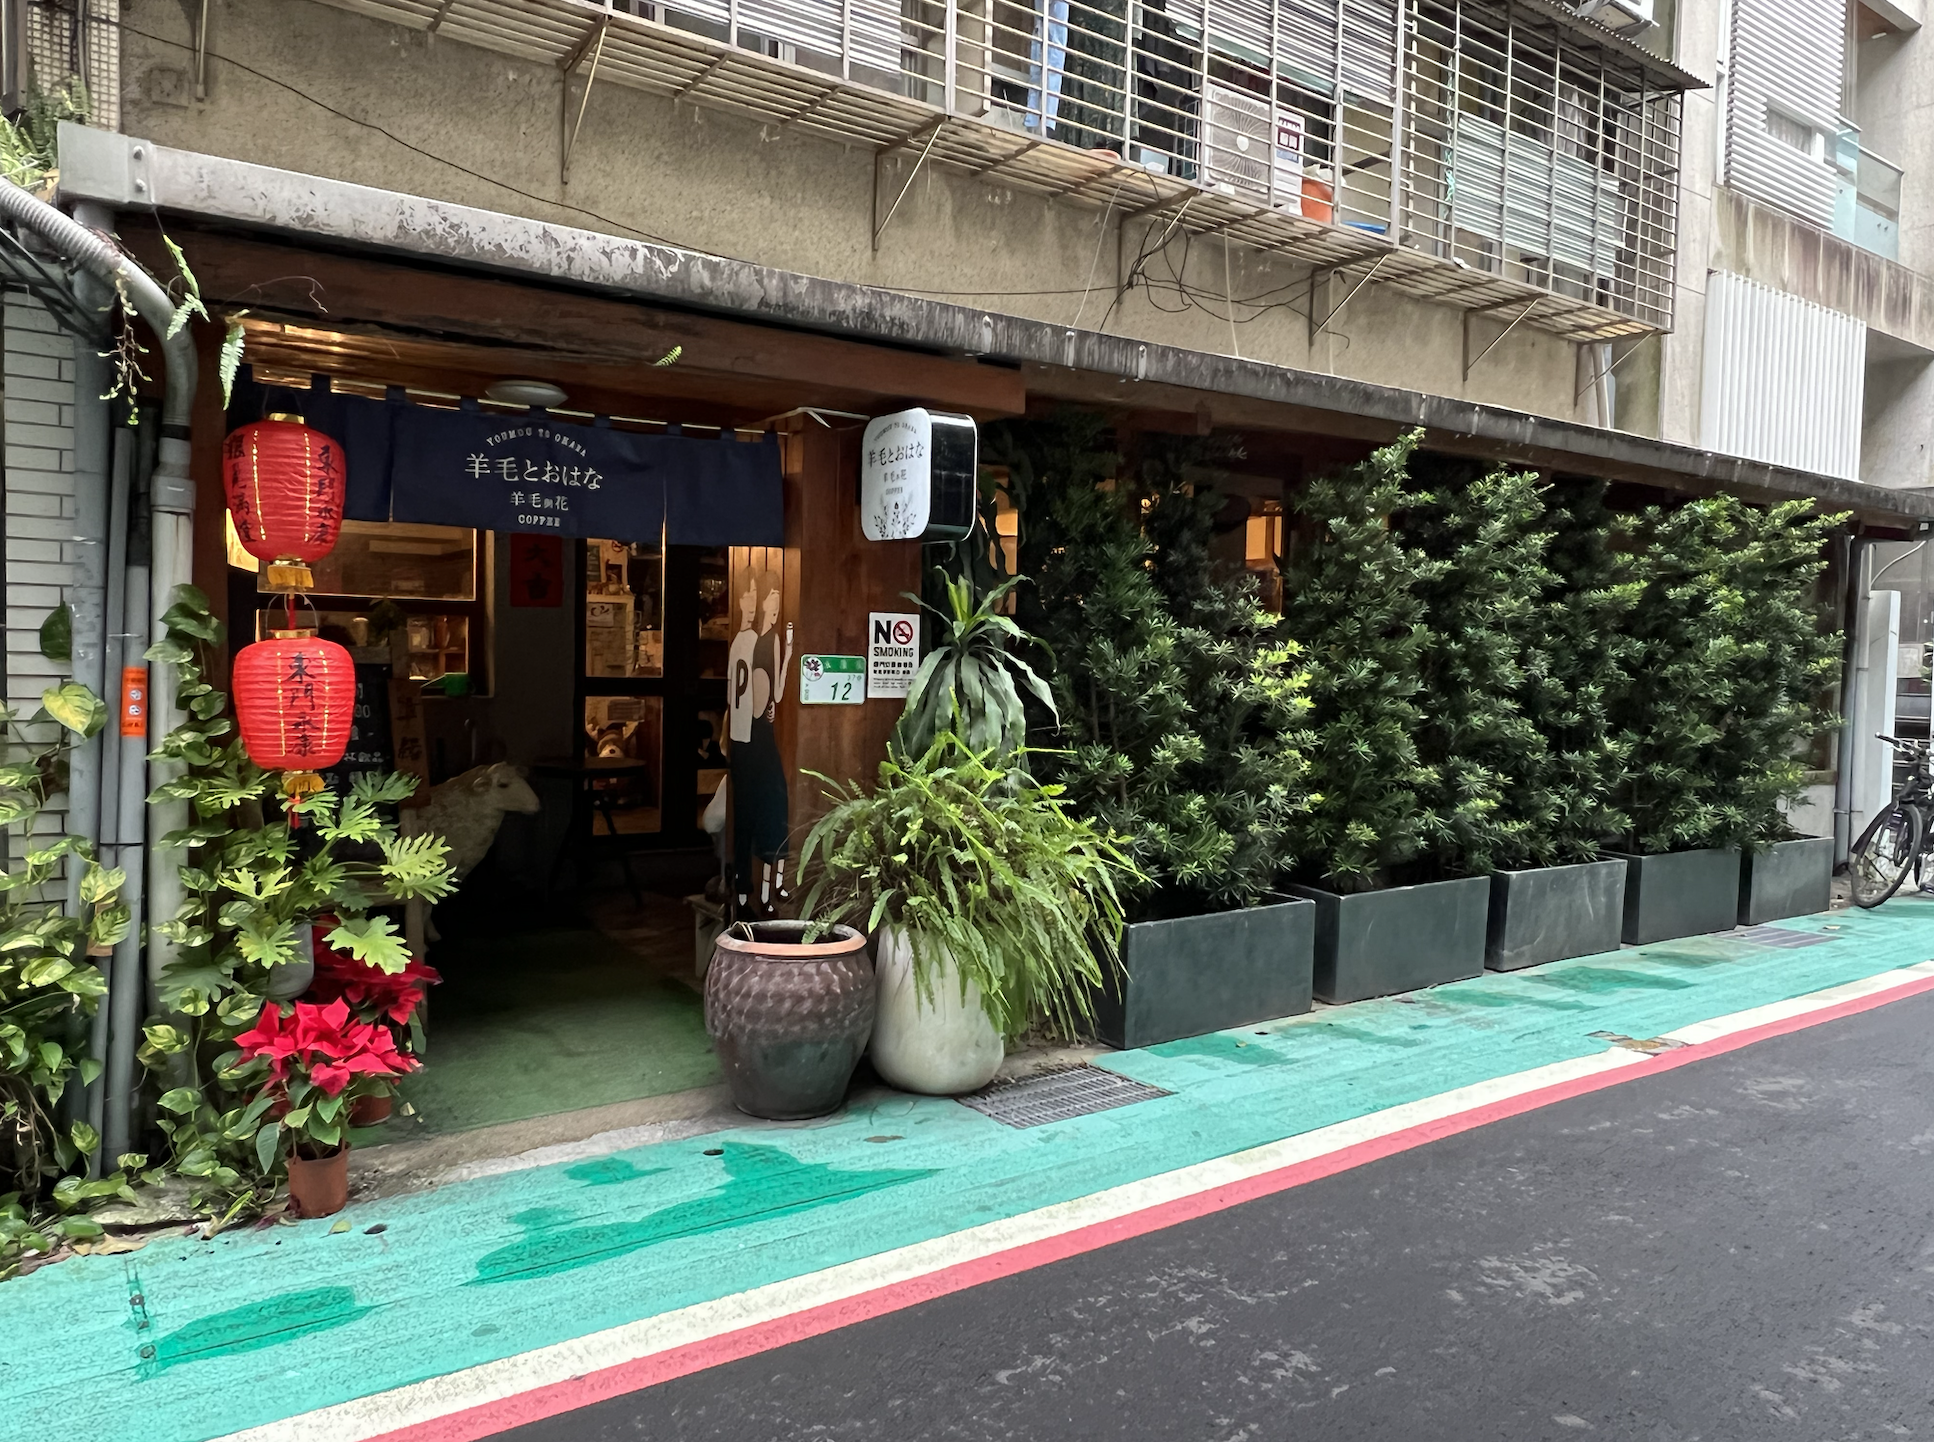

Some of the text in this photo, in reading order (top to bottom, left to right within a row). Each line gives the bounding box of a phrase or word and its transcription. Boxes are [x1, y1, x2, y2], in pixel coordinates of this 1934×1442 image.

[486, 427, 588, 458] YOUMOU TO OHANA
[868, 441, 924, 467] 羊毛とおはな
[465, 452, 604, 490] 羊毛とおはな
[518, 514, 561, 528] COFFEE
[873, 647, 914, 658] SMOKING
[284, 651, 321, 757] 東門永康
[831, 682, 852, 701] 12
